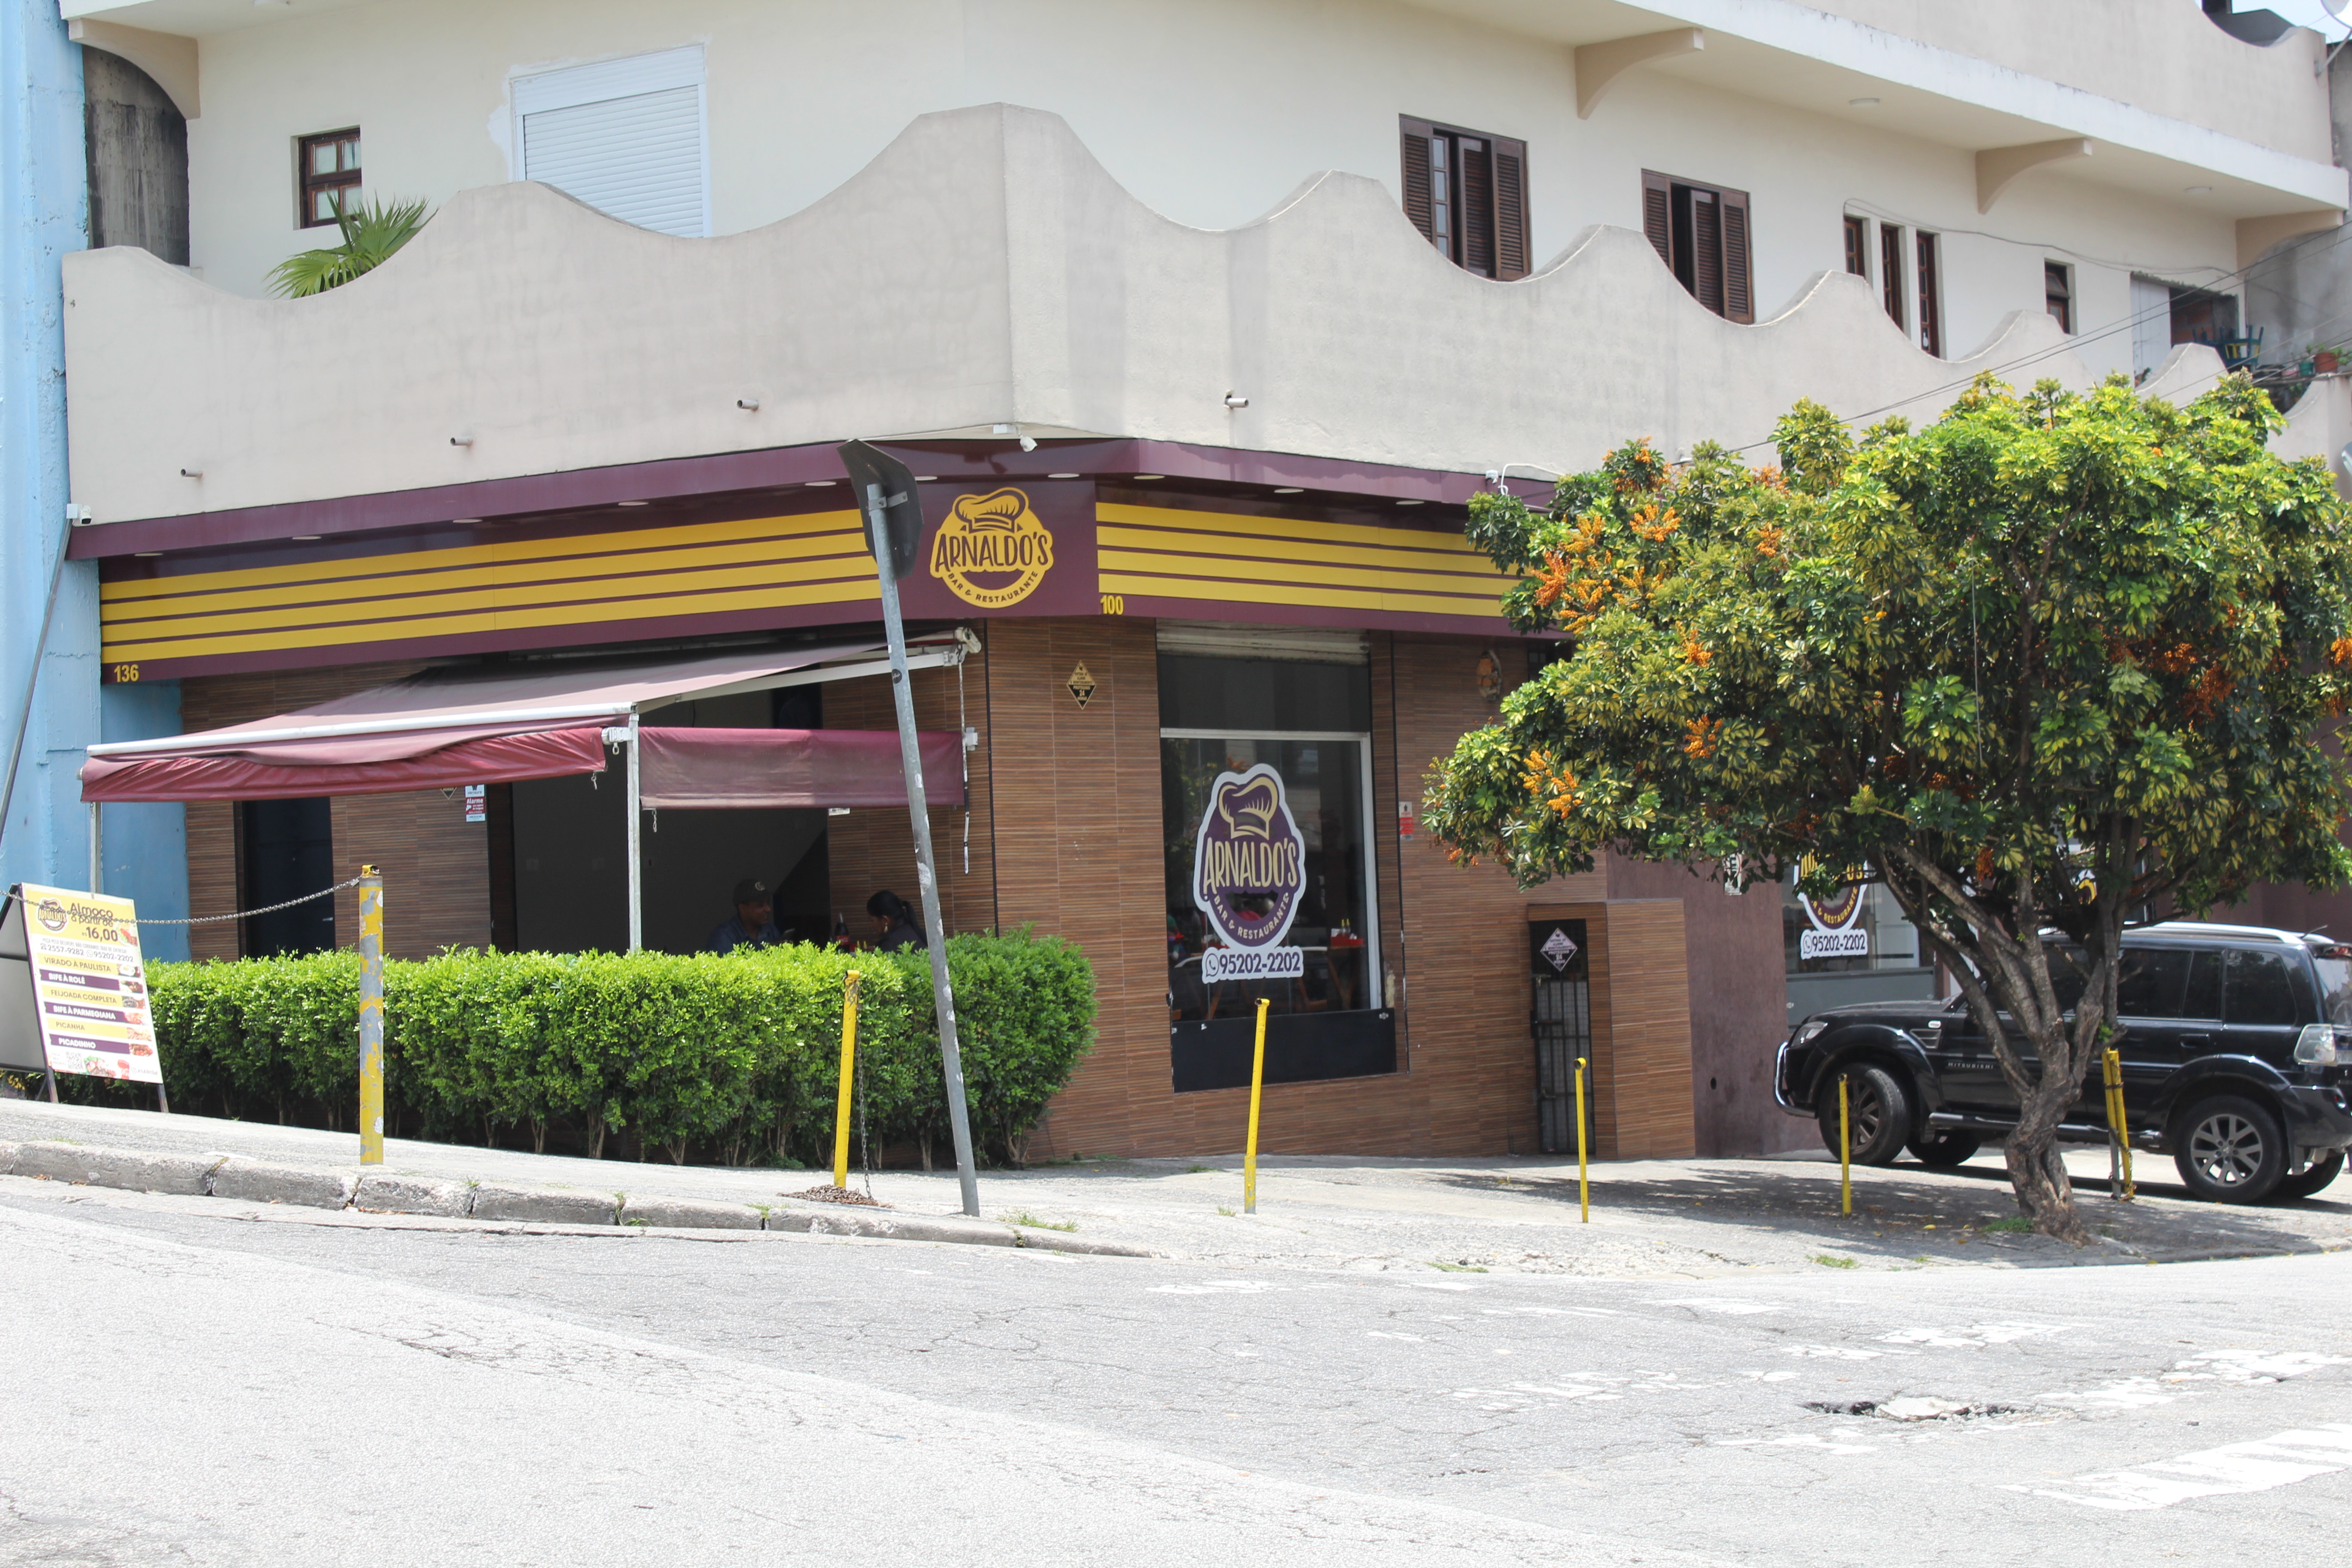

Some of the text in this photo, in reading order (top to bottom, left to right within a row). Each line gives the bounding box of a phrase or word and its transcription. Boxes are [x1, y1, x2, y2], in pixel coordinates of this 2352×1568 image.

[935, 532, 1049, 572] ARNALDO'S
[948, 573, 963, 591] BAR
[975, 571, 1038, 603] RESTAURANTE
[1100, 595, 1124, 615] 100
[114, 664, 139, 682] 136
[1203, 837, 1297, 895] ARNALDO'S
[1214, 893, 1290, 939] BAR & RESTAURANTE
[86, 926, 118, 942] 16,00
[1812, 934, 1865, 952] 95202-2202
[47, 945, 134, 962] 2557-9282 95202-2202
[44, 957, 72, 966] VIRADO
[80, 963, 111, 972] PAULISTA
[1220, 952, 1300, 974] 95202-2202
[49, 973, 86, 984] BIFE À ROLÊ
[51, 990, 117, 1004] FEIJOADA COMPLETA
[53, 1005, 116, 1020] BIFE À PARMEGIANA
[56, 1022, 85, 1031] PICANHA
[59, 1038, 96, 1049] PICADINHO
